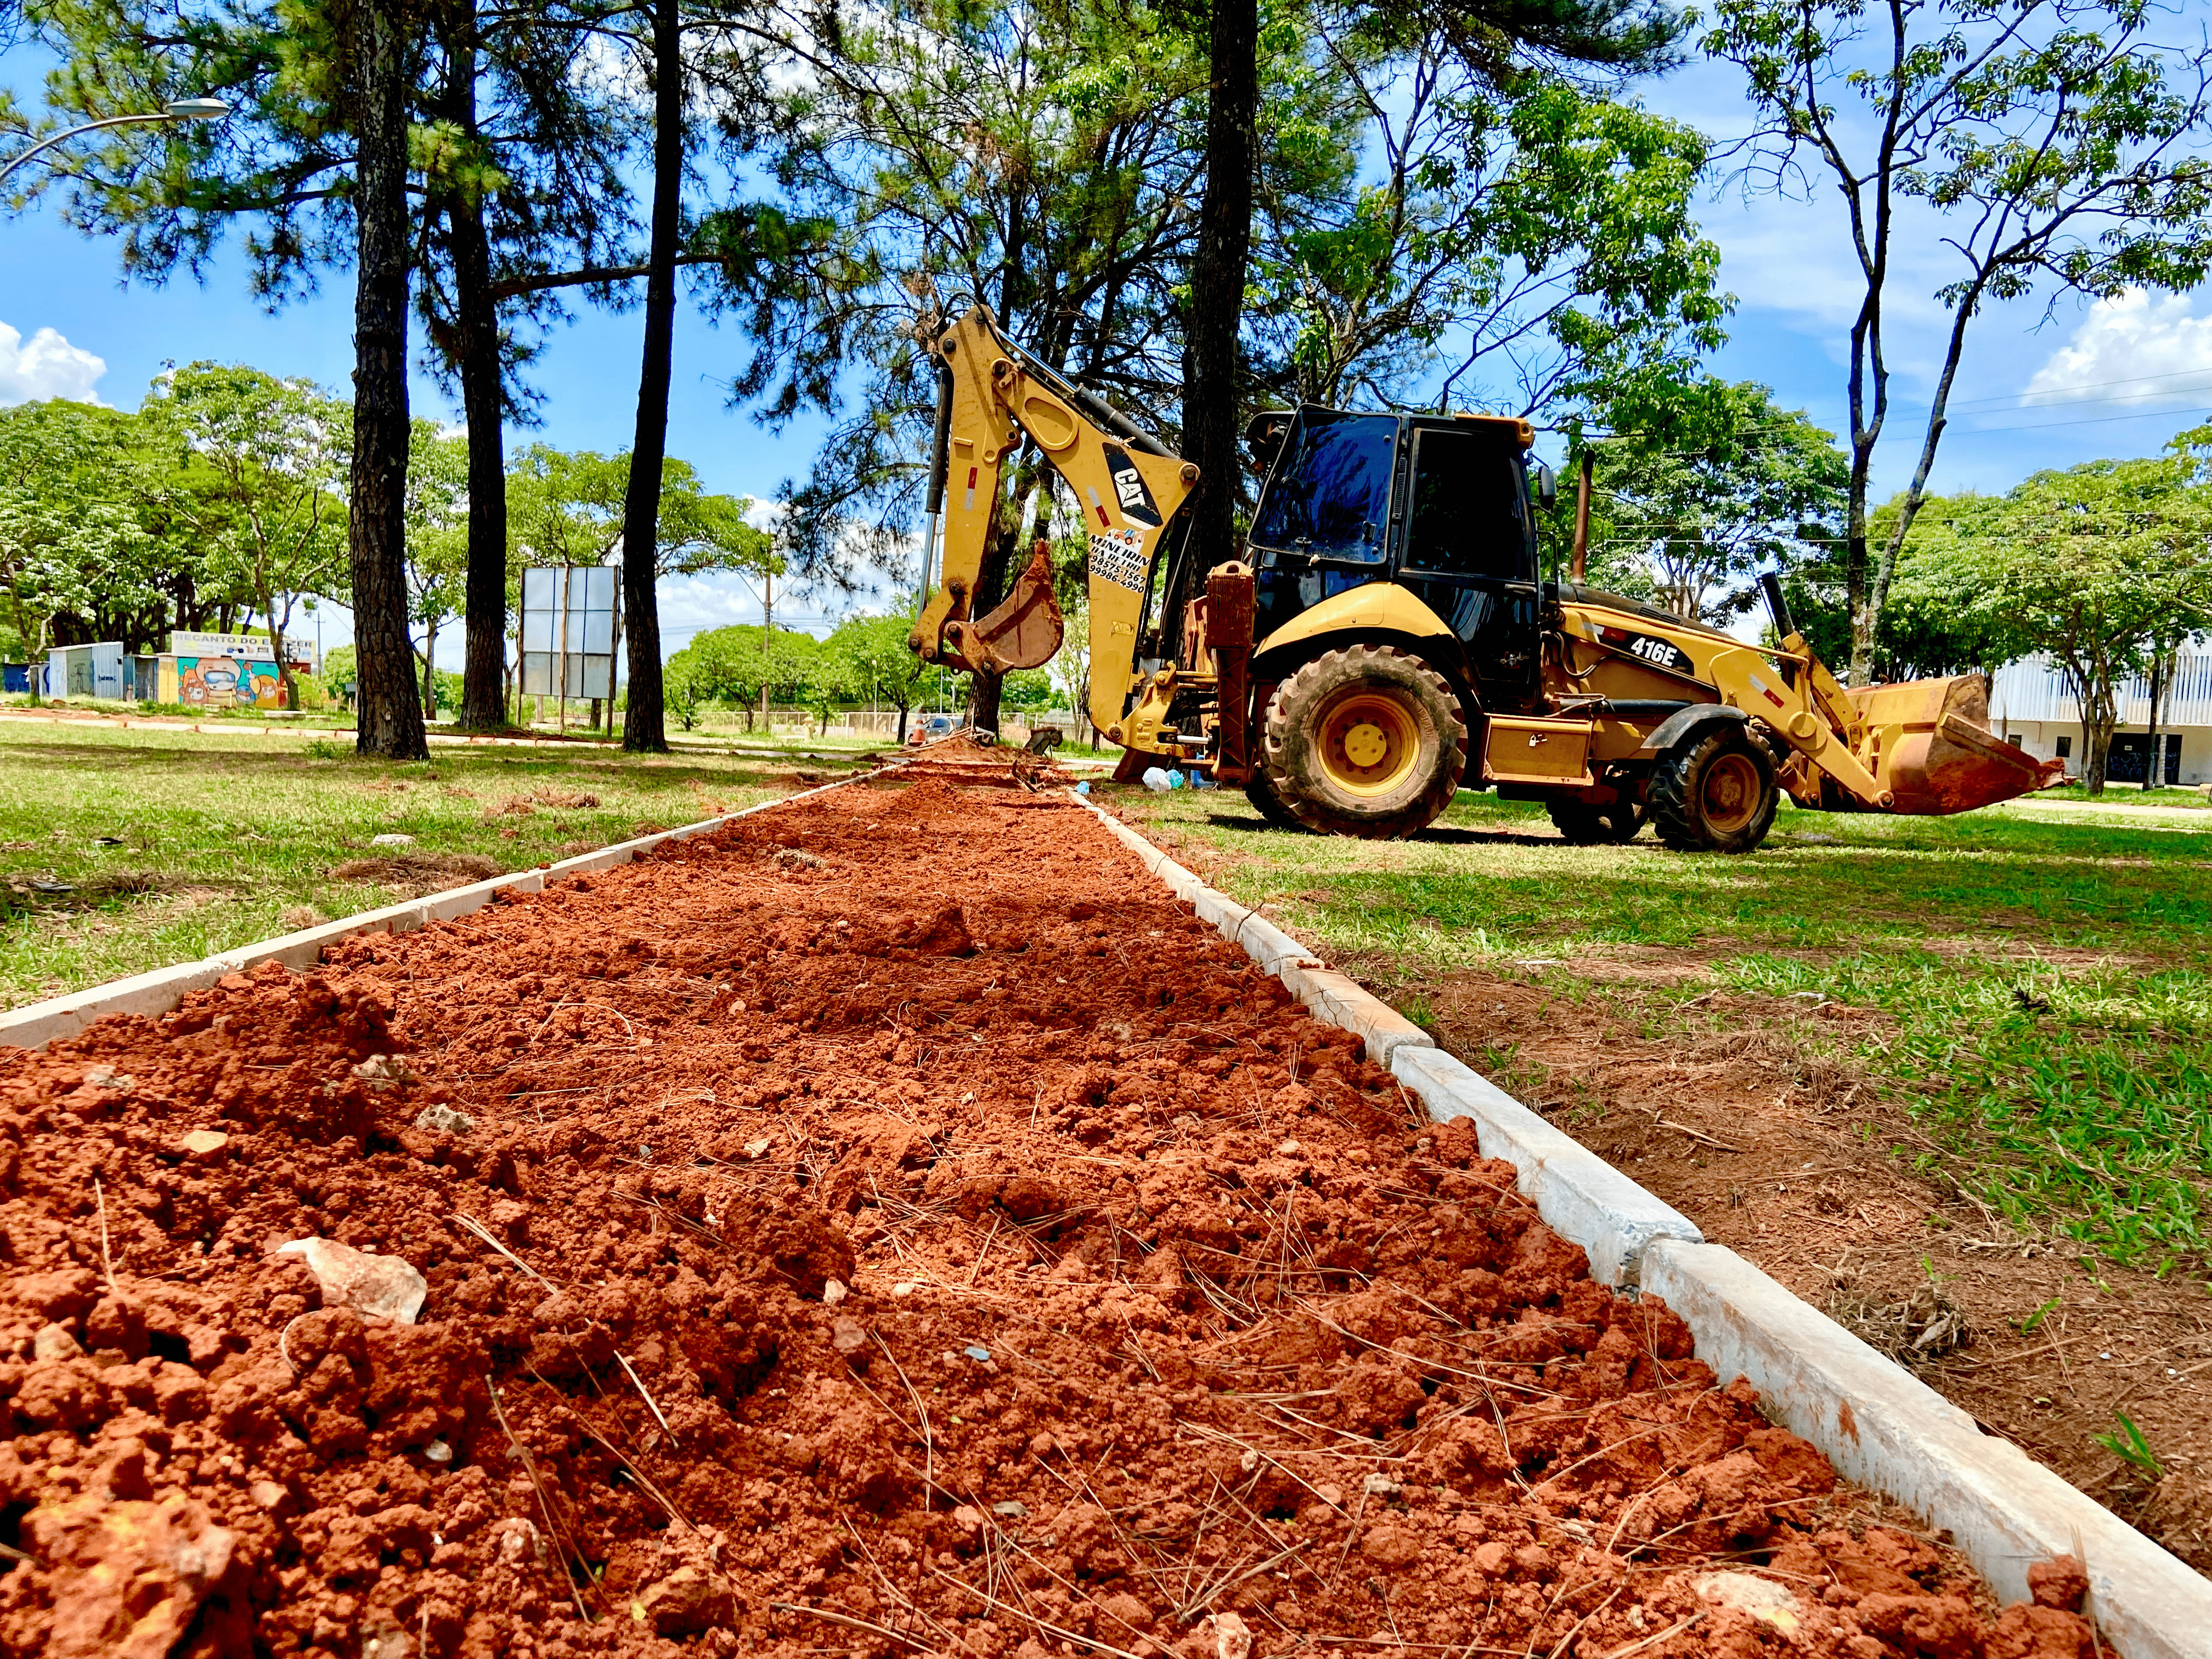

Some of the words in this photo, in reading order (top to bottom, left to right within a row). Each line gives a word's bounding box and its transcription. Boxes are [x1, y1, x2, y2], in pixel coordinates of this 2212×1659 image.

[1114, 468, 1146, 508] CAT
[1089, 534, 1150, 566] MINEIRIN
[1107, 553, 1141, 572] RETRO
[1088, 565, 1144, 593] 99986-4990
[1090, 555, 1147, 584] 98575-1567
[175, 634, 235, 643] RECANTO
[1630, 637, 1678, 667] 416E
